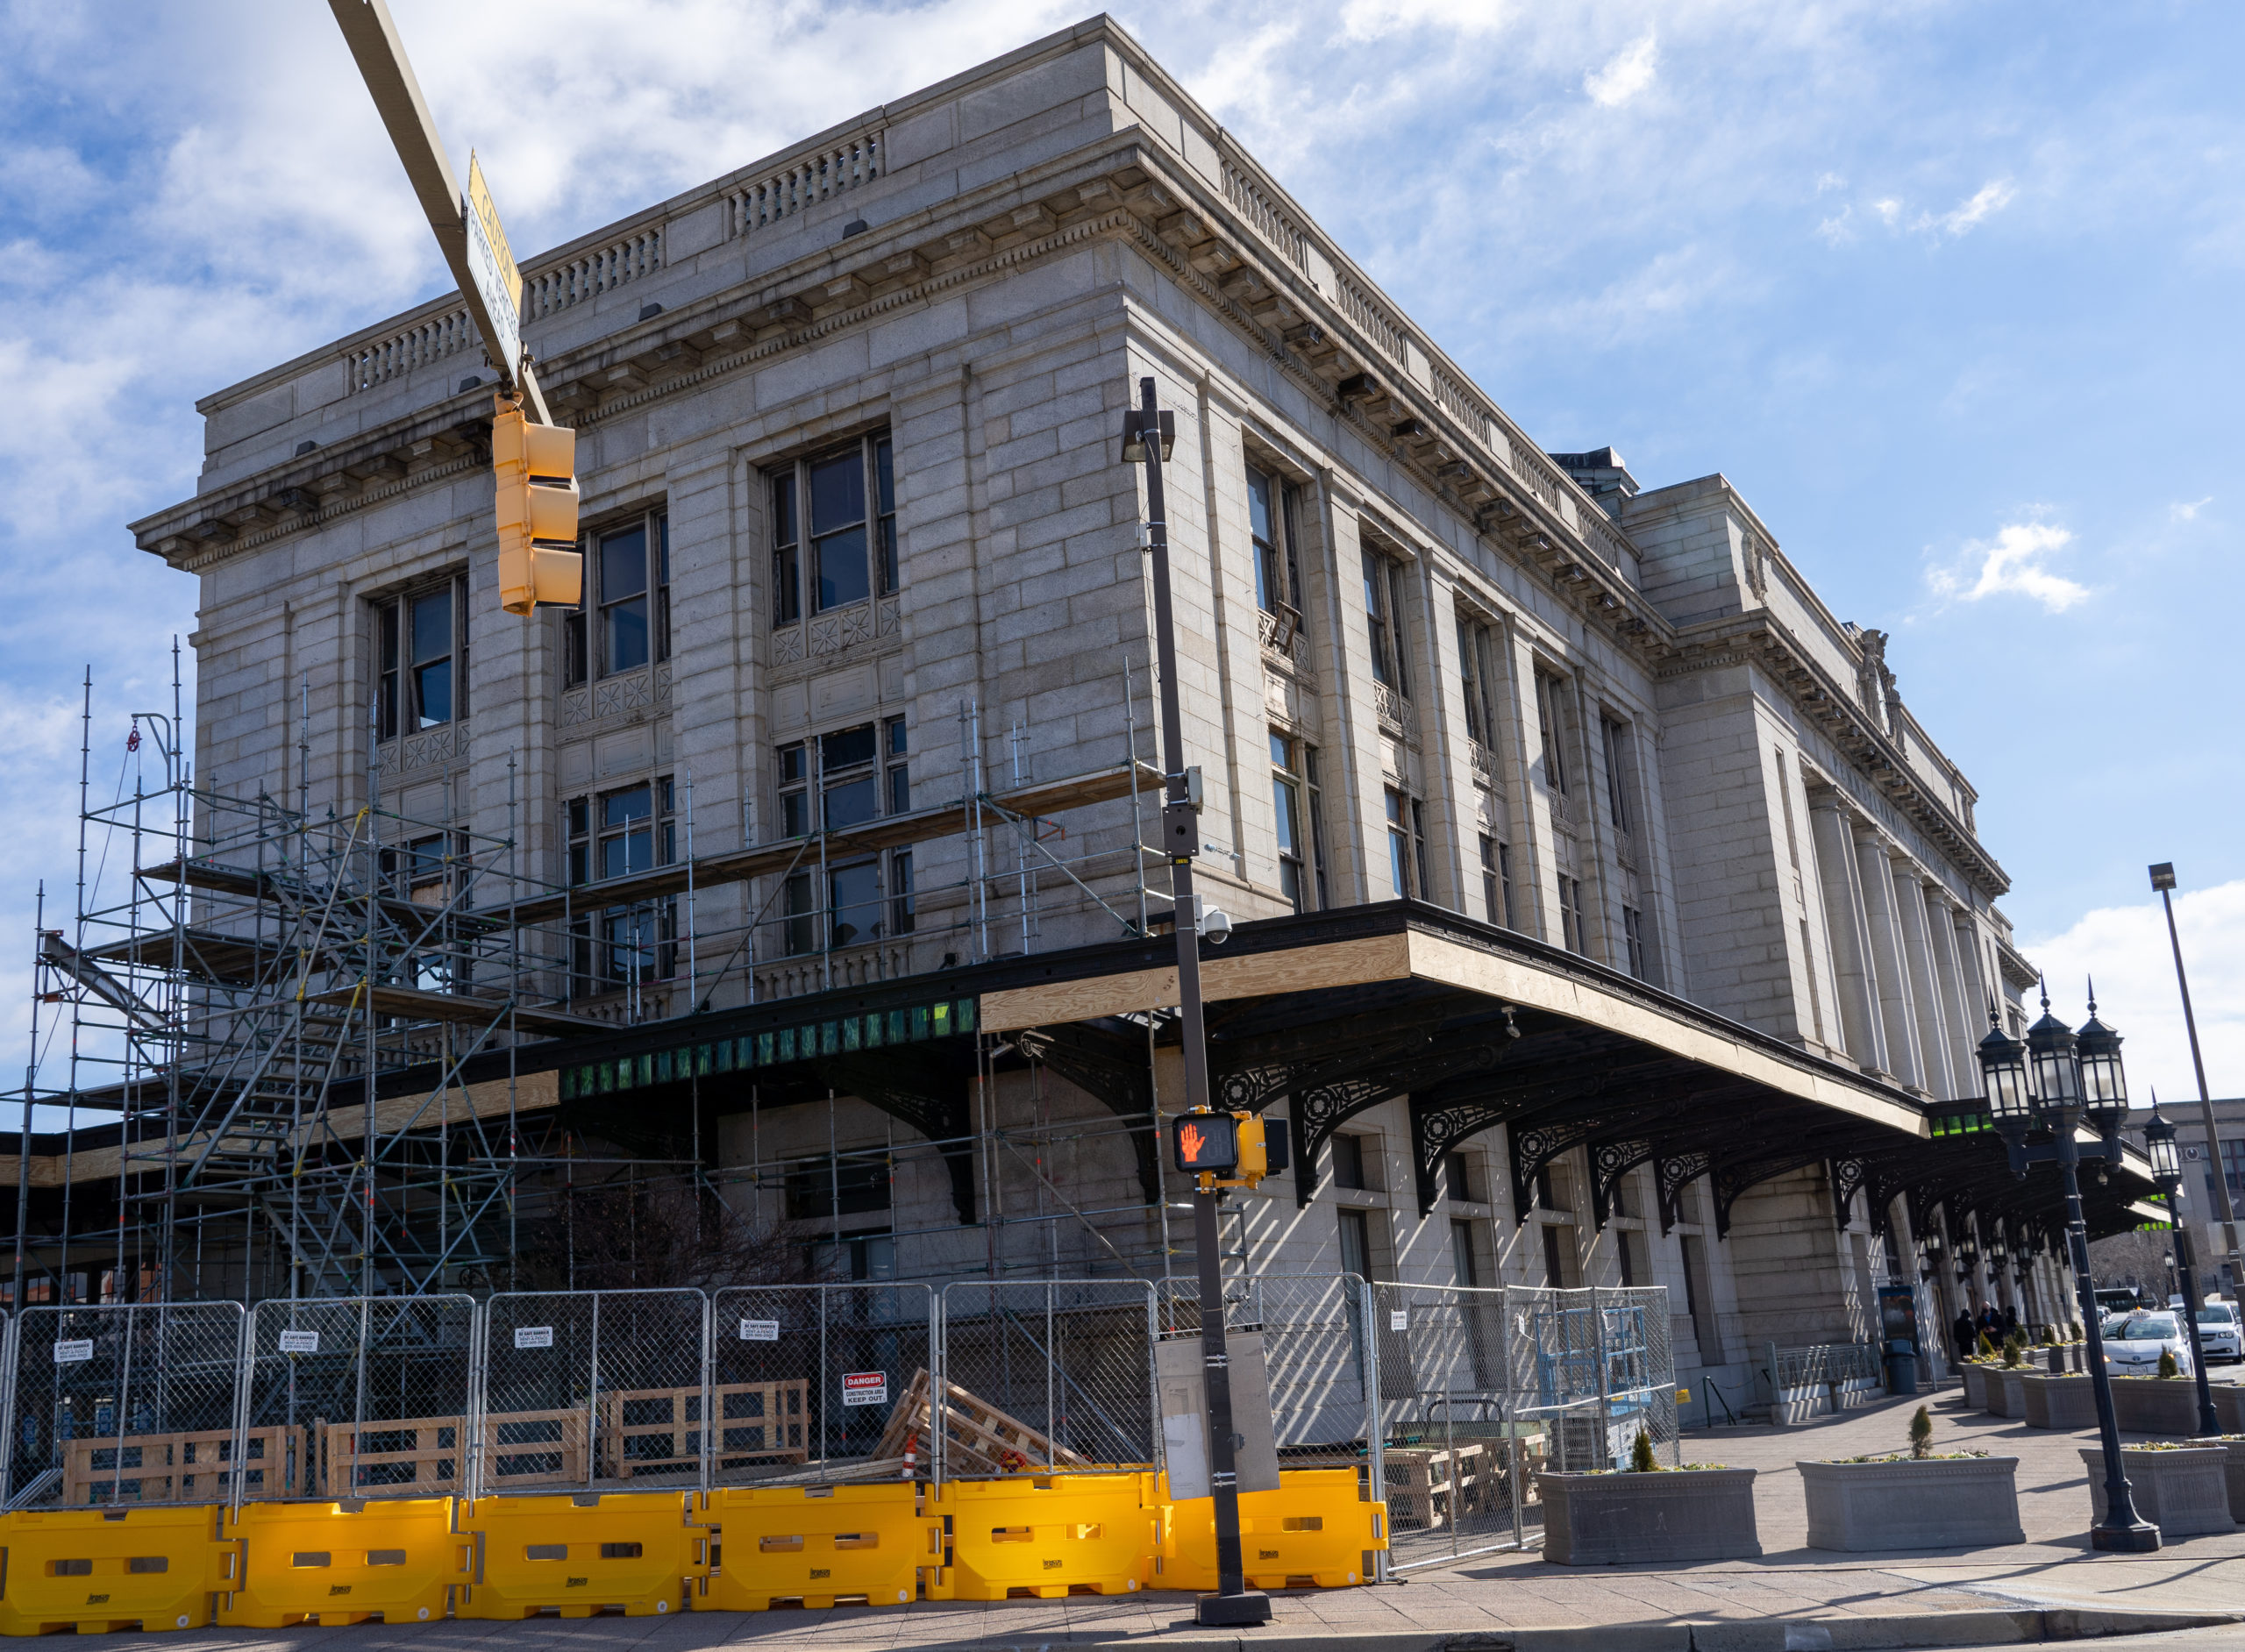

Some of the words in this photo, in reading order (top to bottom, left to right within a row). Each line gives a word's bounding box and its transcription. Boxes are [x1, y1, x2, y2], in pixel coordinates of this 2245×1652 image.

[470, 210, 493, 276] PARKED
[495, 267, 517, 341] VEHICLES
[482, 193, 512, 286] CAUTION
[485, 279, 505, 339] AHEAD
[1831, 752, 1907, 840] PENNSYLVANIA
[847, 1376, 881, 1385] DANGER
